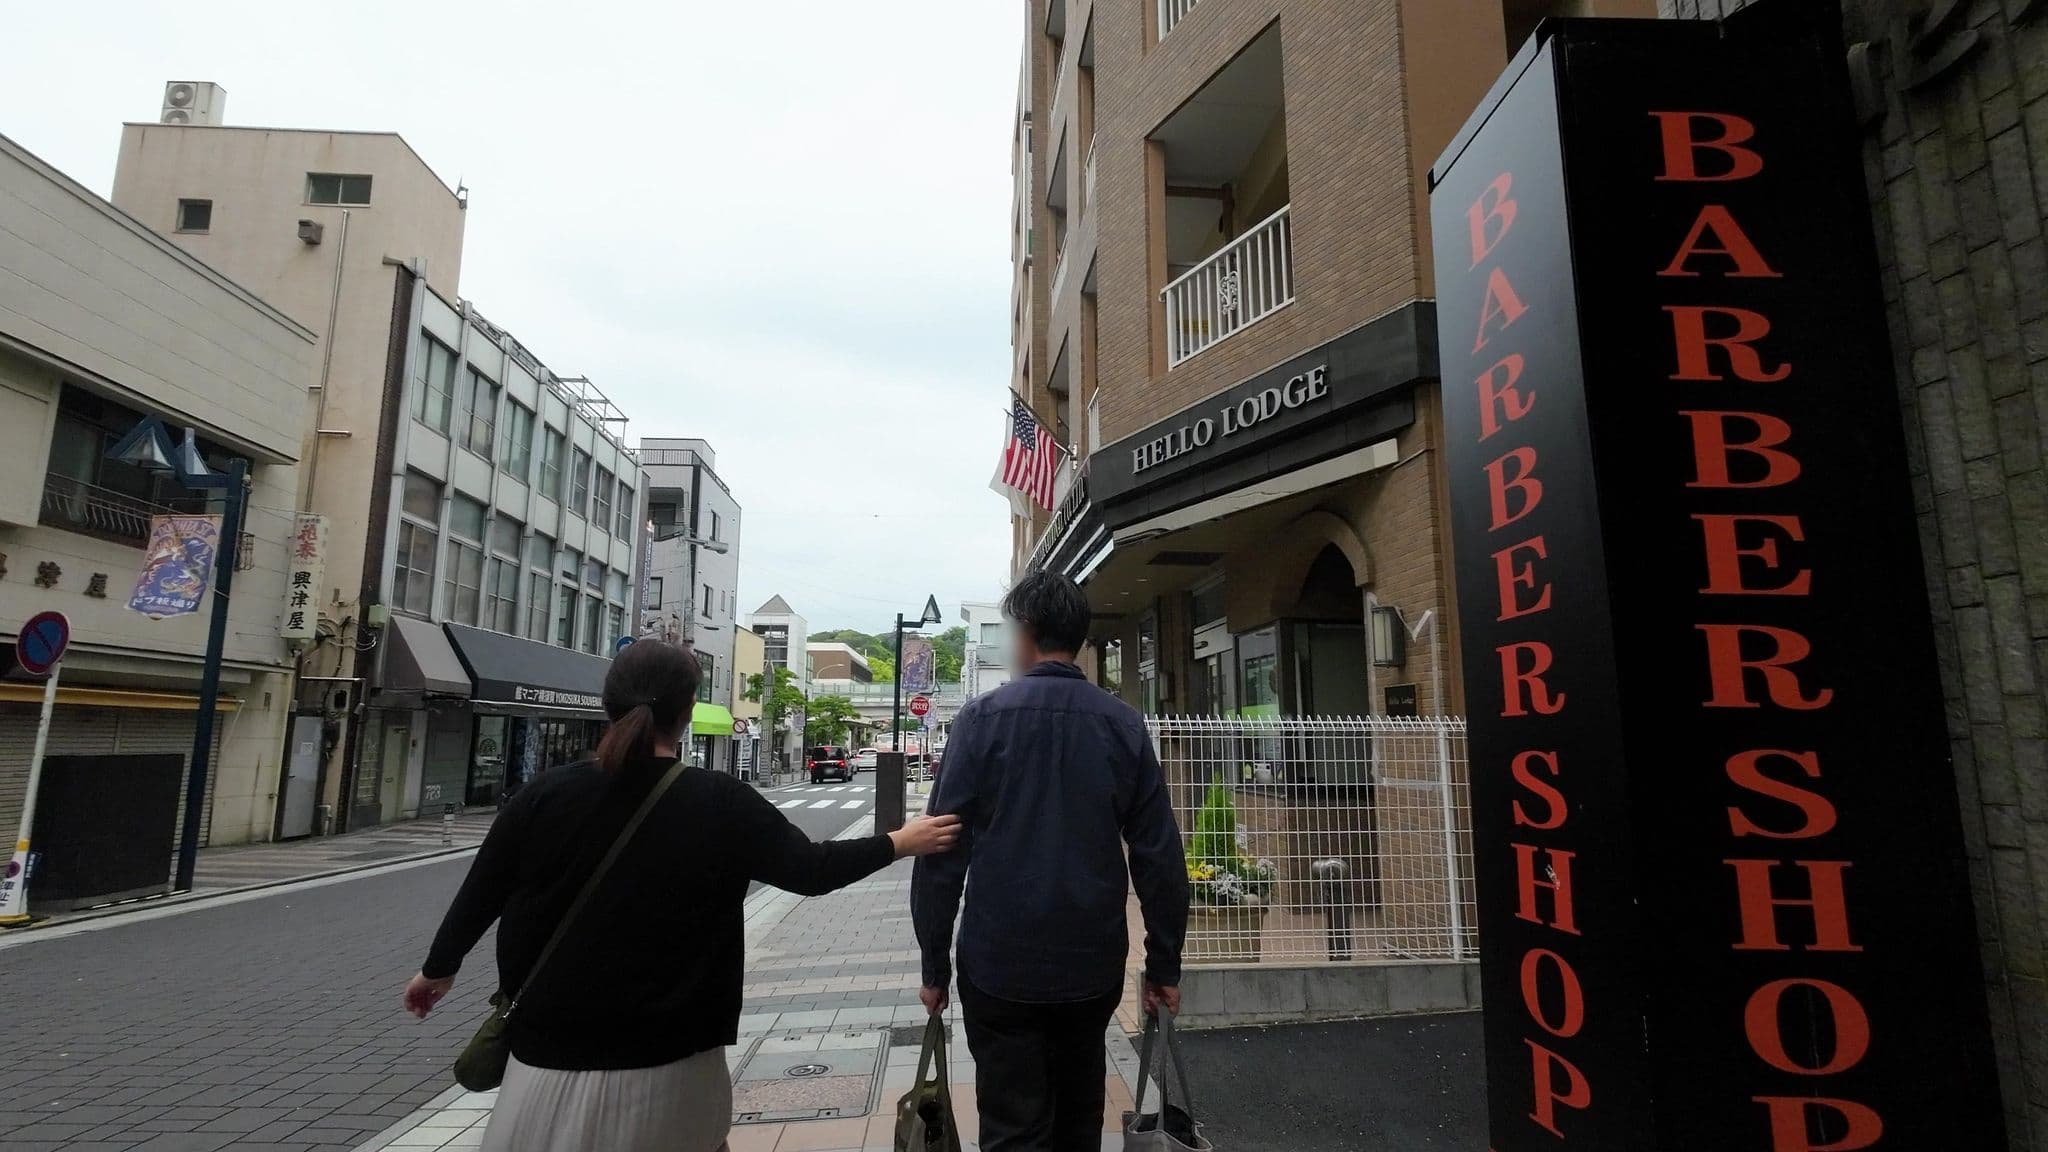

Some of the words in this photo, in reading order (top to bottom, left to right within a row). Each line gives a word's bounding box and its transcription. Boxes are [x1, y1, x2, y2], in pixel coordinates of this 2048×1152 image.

[287, 571, 311, 630] 興津屋
[1131, 418, 1214, 475] HELLO
[1221, 364, 1329, 437] LODGE
[1465, 171, 1566, 717] BARBER
[1648, 111, 1834, 711] BARBER
[1510, 750, 1592, 1140] SHOP
[1723, 749, 1884, 1152] SHOP
